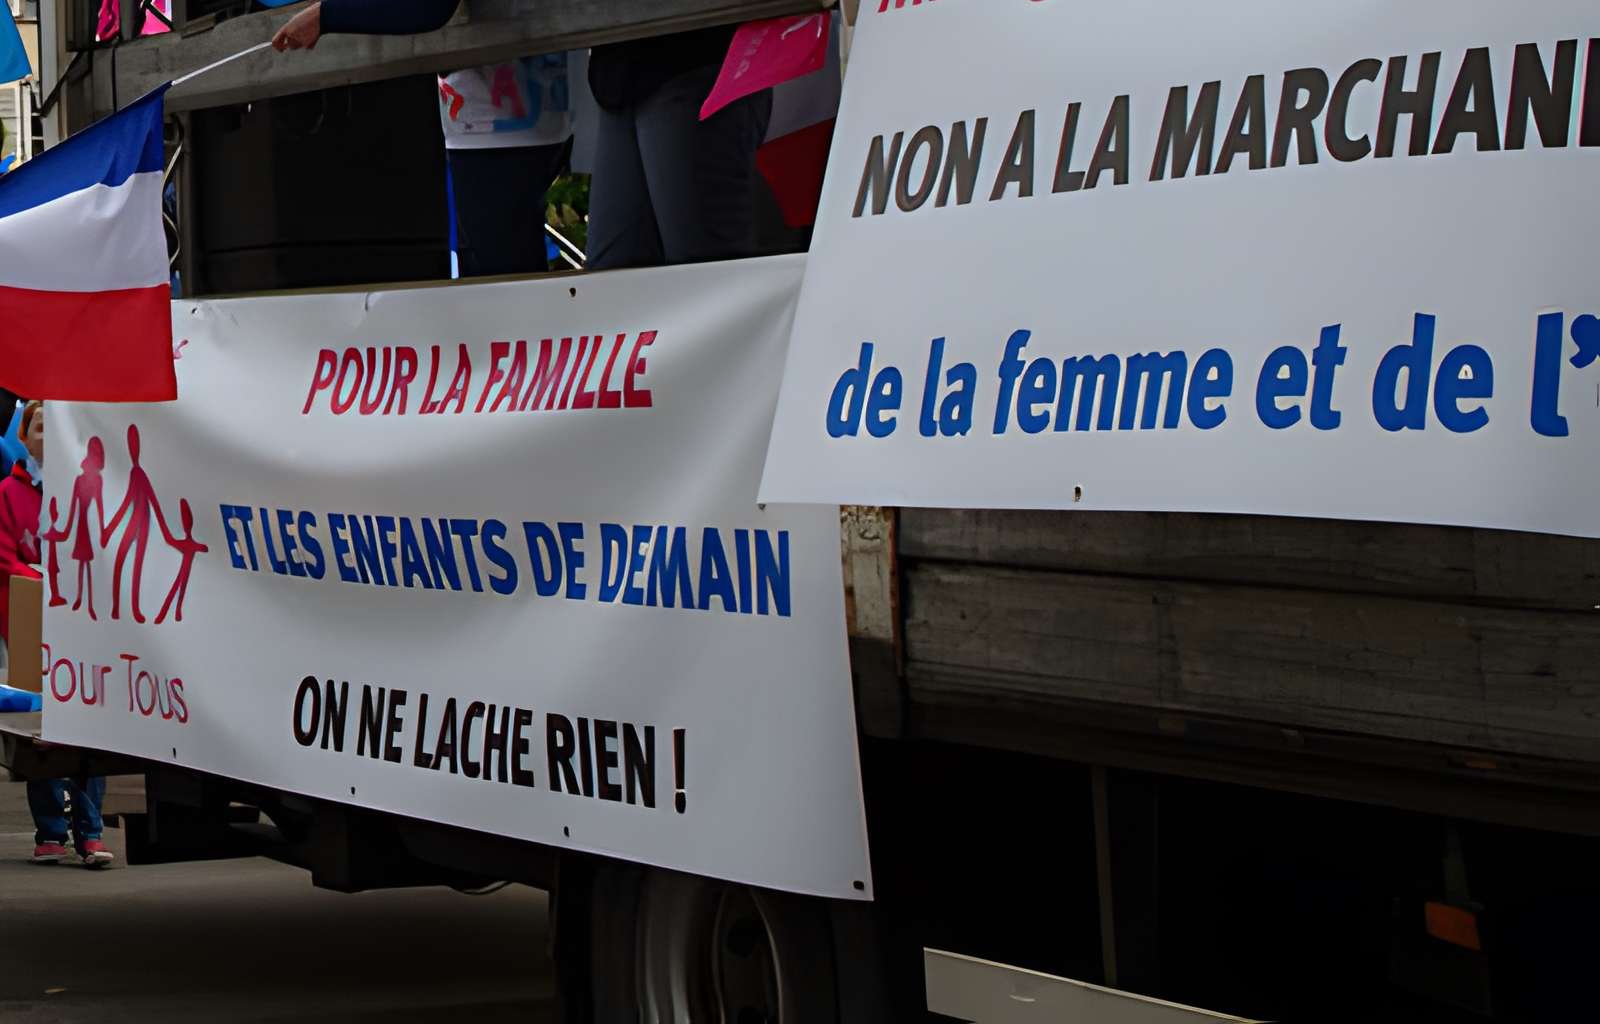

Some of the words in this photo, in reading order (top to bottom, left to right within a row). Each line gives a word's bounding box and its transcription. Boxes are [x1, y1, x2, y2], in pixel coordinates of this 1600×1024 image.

[852, 117, 989, 218] NON
[989, 109, 1035, 201] A
[1052, 94, 1130, 194] LA
[302, 346, 419, 416] POUR
[418, 343, 472, 415] LA
[474, 330, 657, 413] FAMILLE
[826, 342, 903, 438] de
[919, 337, 977, 438] la
[993, 329, 1234, 435] femme
[1255, 323, 1347, 431] et
[1372, 312, 1494, 433] de
[220, 504, 259, 571] ET
[259, 507, 326, 580] LES
[327, 513, 518, 595] ENFANTS
[523, 521, 587, 600] DE
[598, 523, 791, 617] DEMAIN
[118, 652, 190, 725] Tous
[293, 675, 350, 753] ON
[356, 684, 408, 764] NE
[413, 692, 535, 788] LACHE
[546, 712, 656, 809] RIEN
